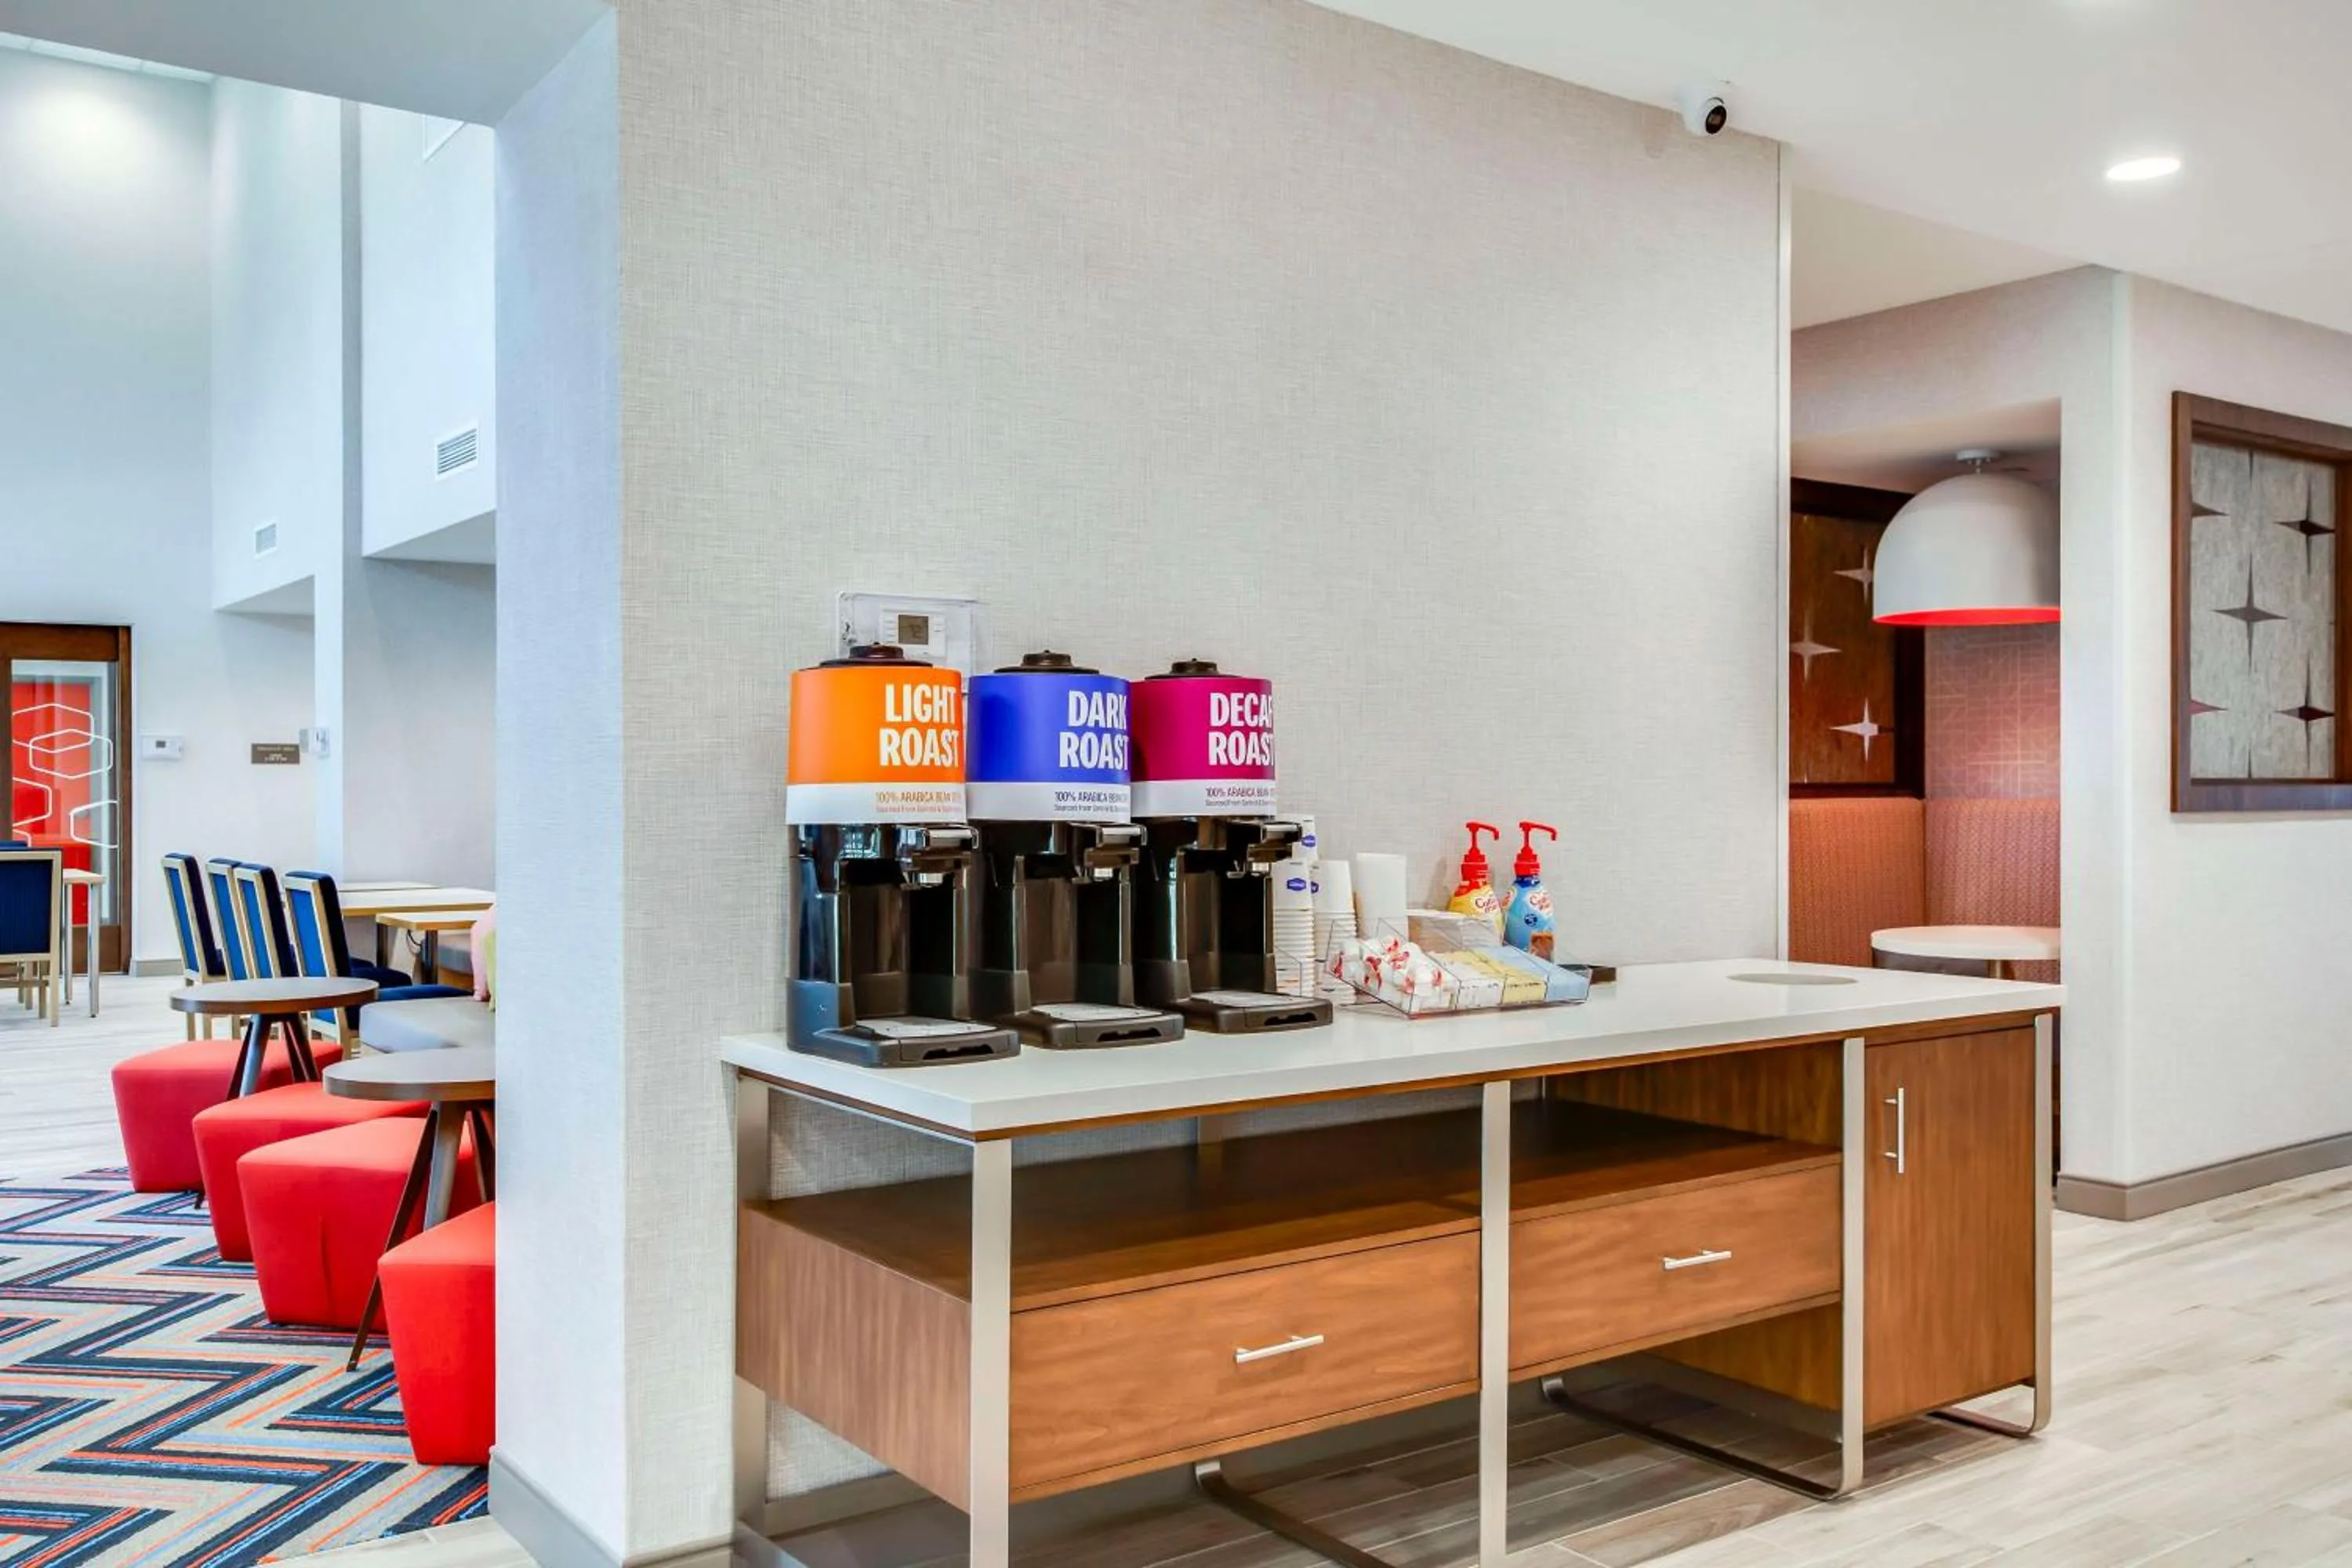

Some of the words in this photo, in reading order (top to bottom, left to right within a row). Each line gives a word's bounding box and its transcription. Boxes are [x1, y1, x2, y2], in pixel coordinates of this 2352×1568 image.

[885, 684, 956, 724] LIGHT
[1068, 690, 1127, 730] DARK
[879, 727, 960, 768] ROAST
[1059, 731, 1129, 771] ROAST
[1208, 730, 1274, 766] ROAST
[1054, 790, 1076, 802] 100%
